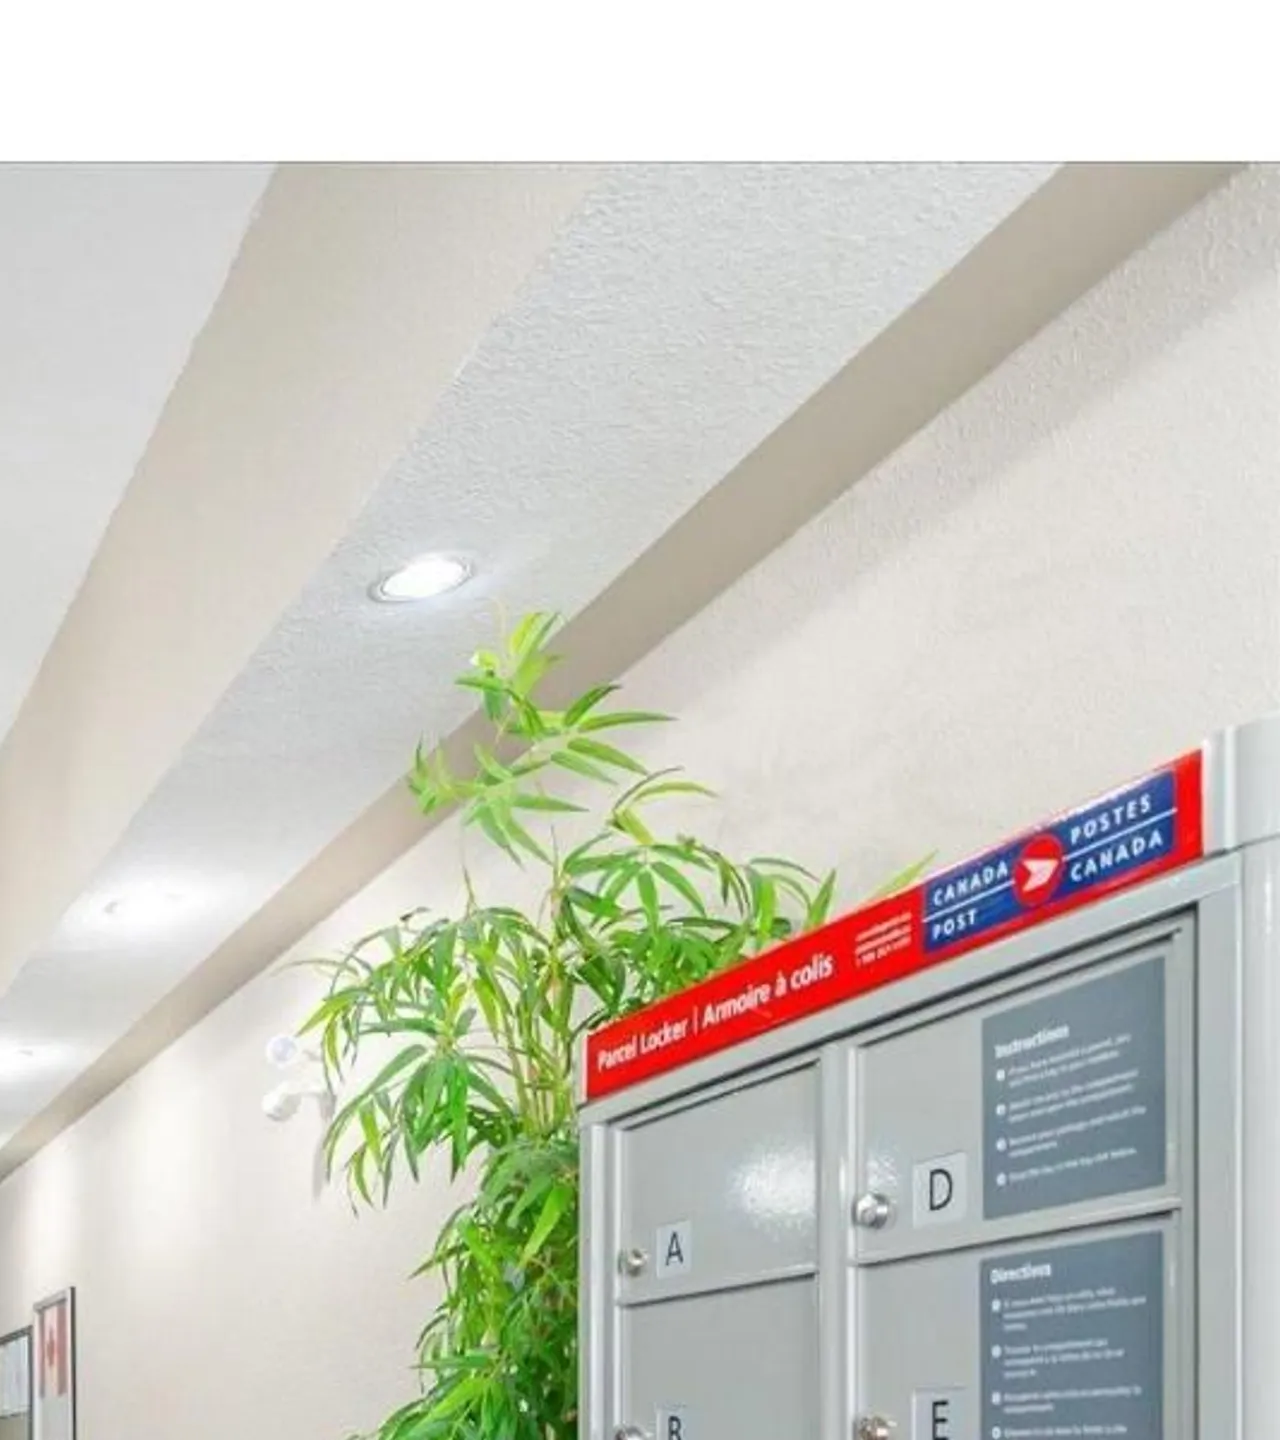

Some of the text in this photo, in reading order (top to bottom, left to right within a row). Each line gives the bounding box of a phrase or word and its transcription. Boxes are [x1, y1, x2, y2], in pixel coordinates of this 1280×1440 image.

[1070, 793, 1151, 846] POSTES
[1070, 830, 1164, 882] CANADA
[932, 860, 1009, 906] CANADA
[932, 909, 978, 941] POST
[597, 1034, 637, 1073] Parcel
[640, 1017, 689, 1055] Locker
[702, 983, 772, 1029] Armoire
[775, 968, 788, 998] à
[790, 952, 834, 990] colis
[929, 1168, 953, 1211] D
[665, 1231, 684, 1266] A
